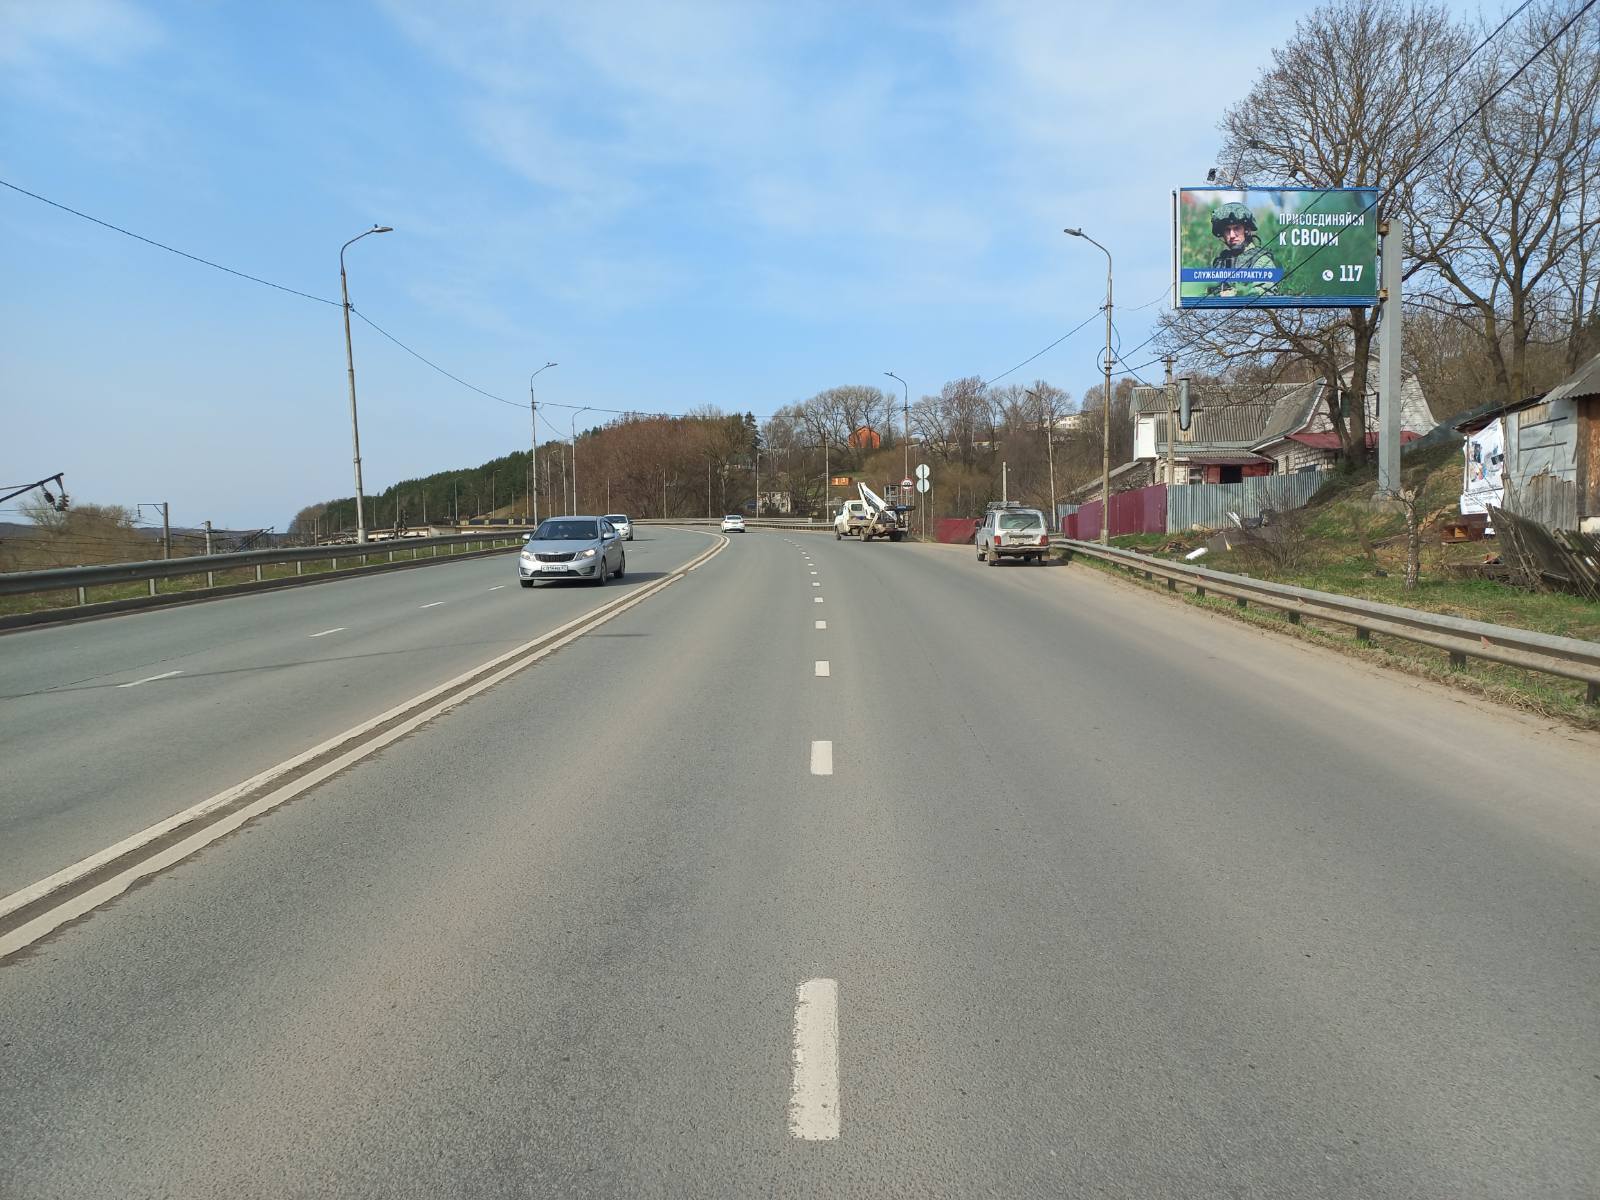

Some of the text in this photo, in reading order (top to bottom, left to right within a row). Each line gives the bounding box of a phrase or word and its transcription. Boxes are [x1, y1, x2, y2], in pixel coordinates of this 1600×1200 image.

[1279, 212, 1365, 226] ПРИСОЕДИНЯЙСЯ
[1193, 270, 1273, 280] СЛУЖБАПОКОНТРАКТУ.РФ
[1339, 264, 1364, 282] 117
